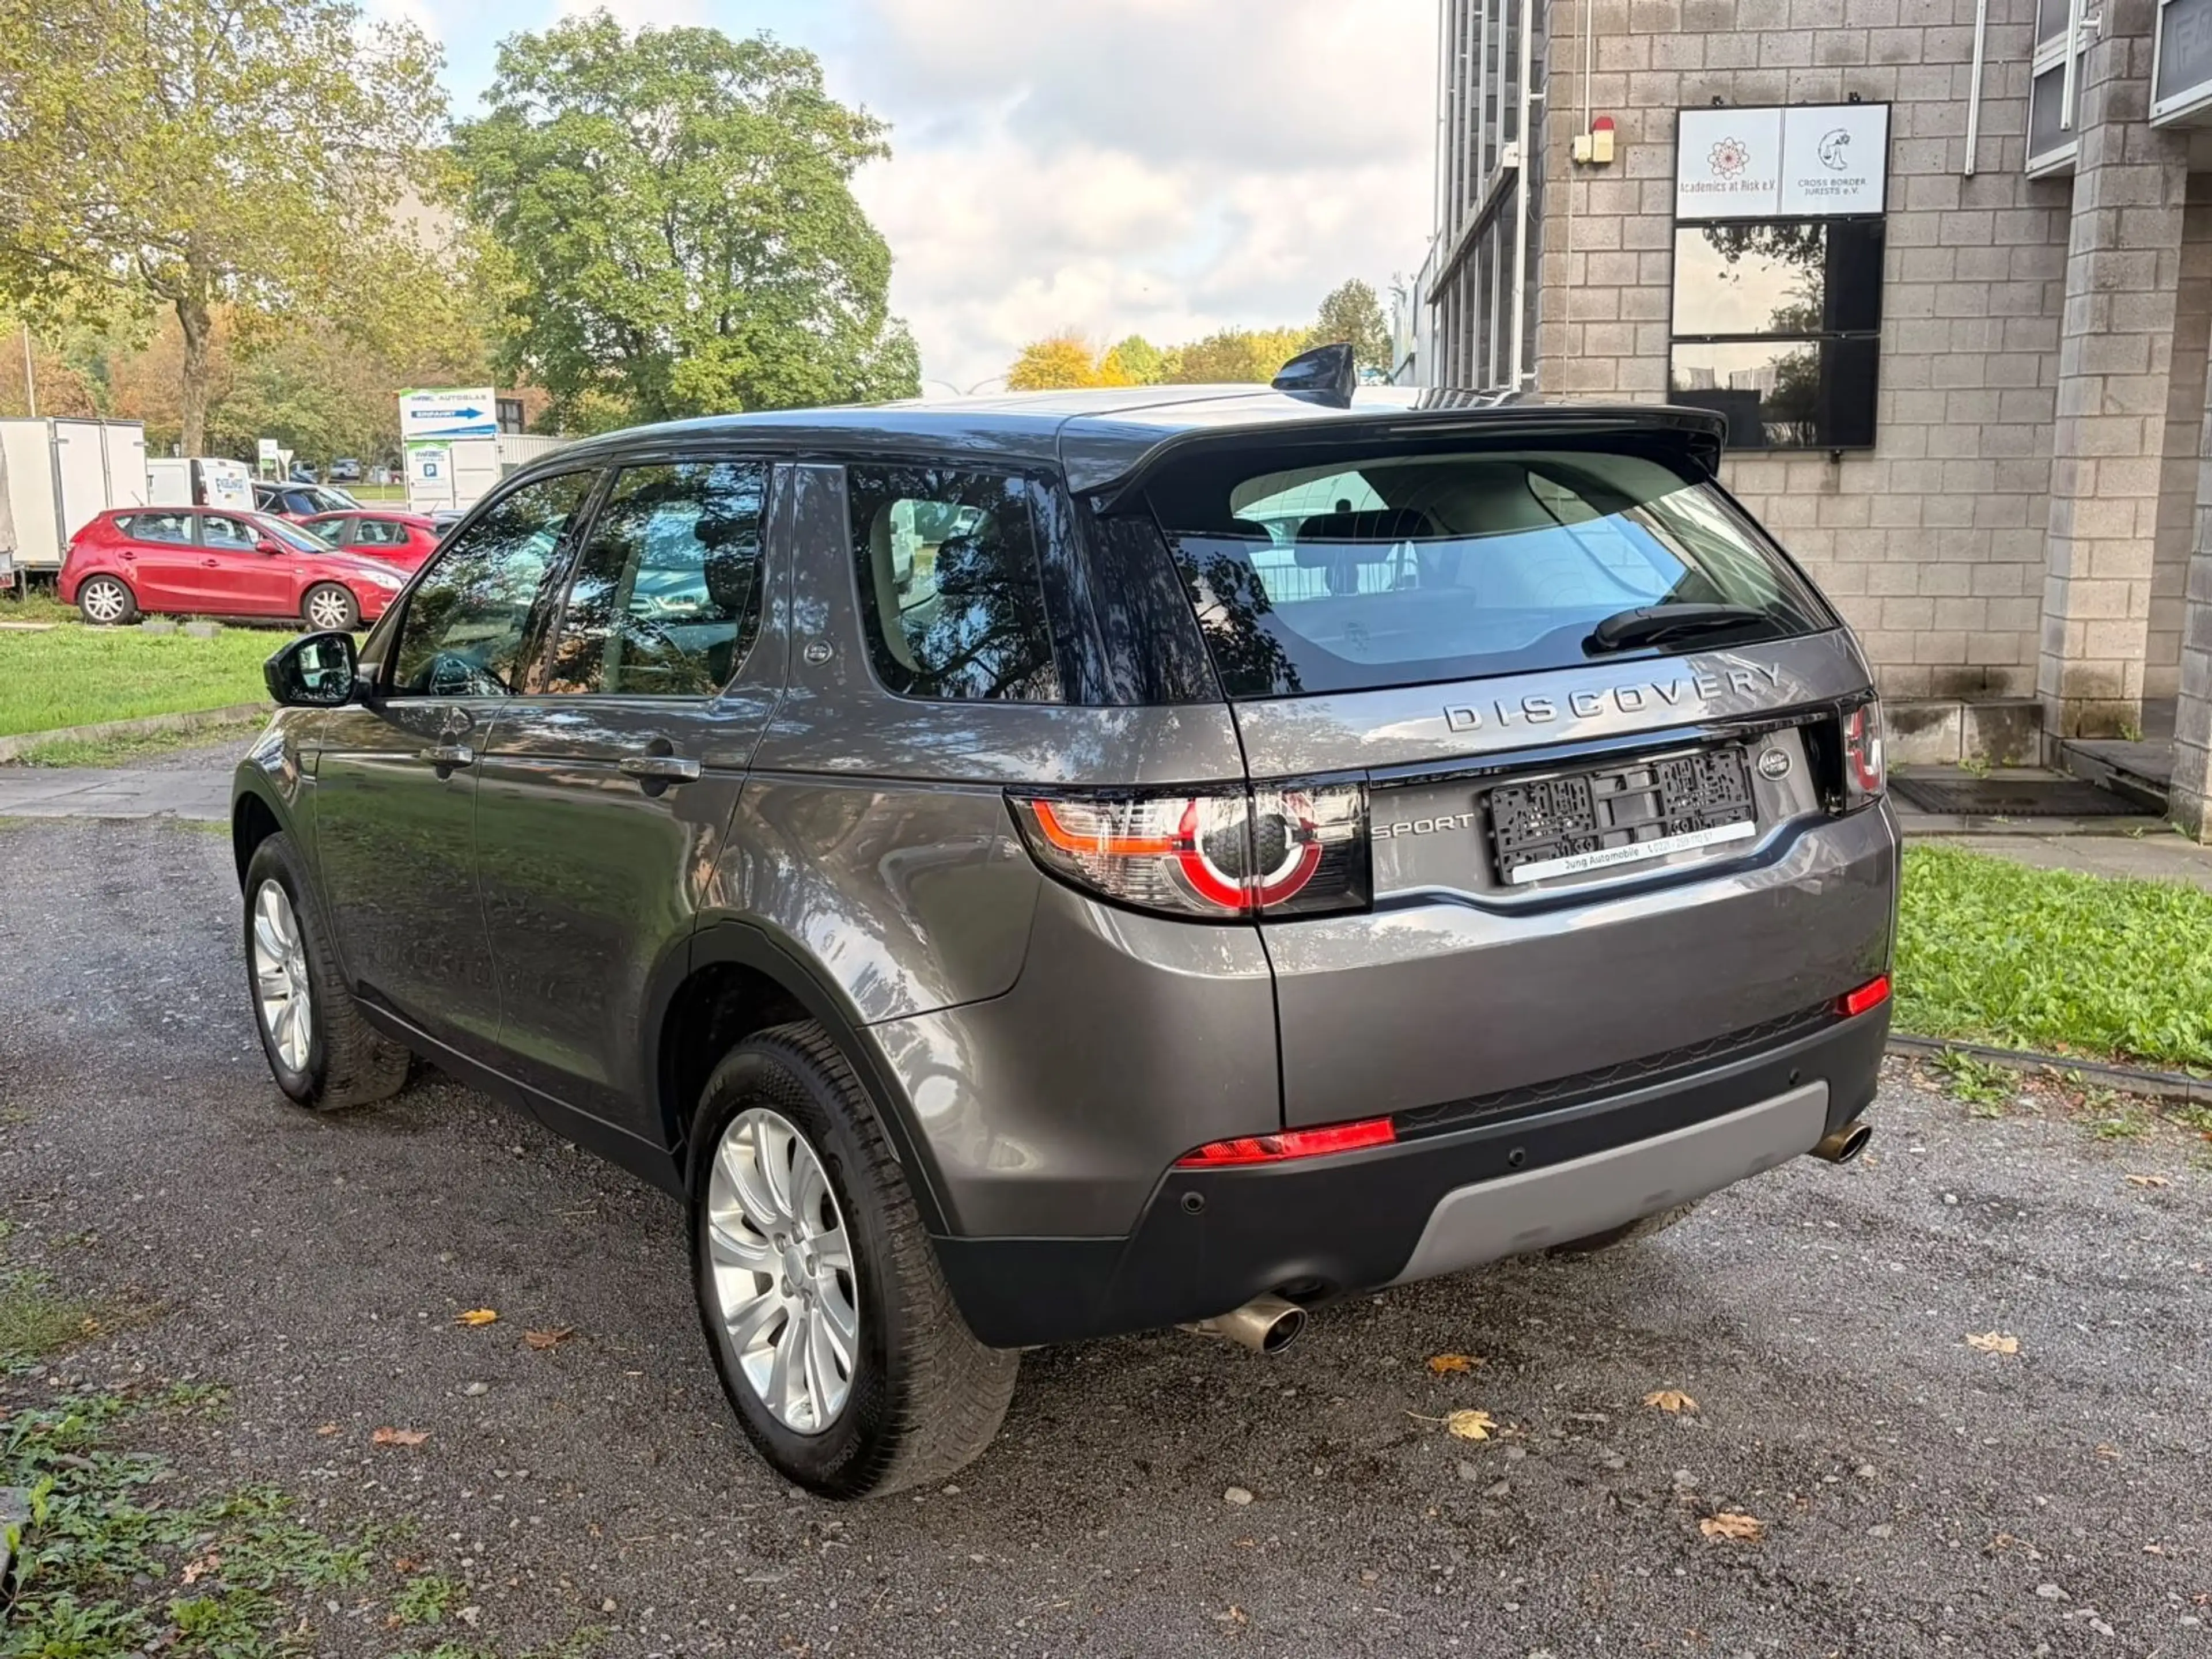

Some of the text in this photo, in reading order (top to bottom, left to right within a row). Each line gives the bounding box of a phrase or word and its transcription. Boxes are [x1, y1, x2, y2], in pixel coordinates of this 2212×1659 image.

[1680, 181, 1726, 192] Academics
[1729, 181, 1738, 192] at
[1741, 179, 1759, 192] Risk
[1797, 177, 1866, 187] CROSS BORDER
[1804, 187, 1840, 196] JURISTS
[1444, 664, 1781, 733] DISCOVERY
[1370, 812, 1475, 842] SPORT
[1565, 859, 1588, 870] Jung
[1589, 846, 1639, 864] Automobile
